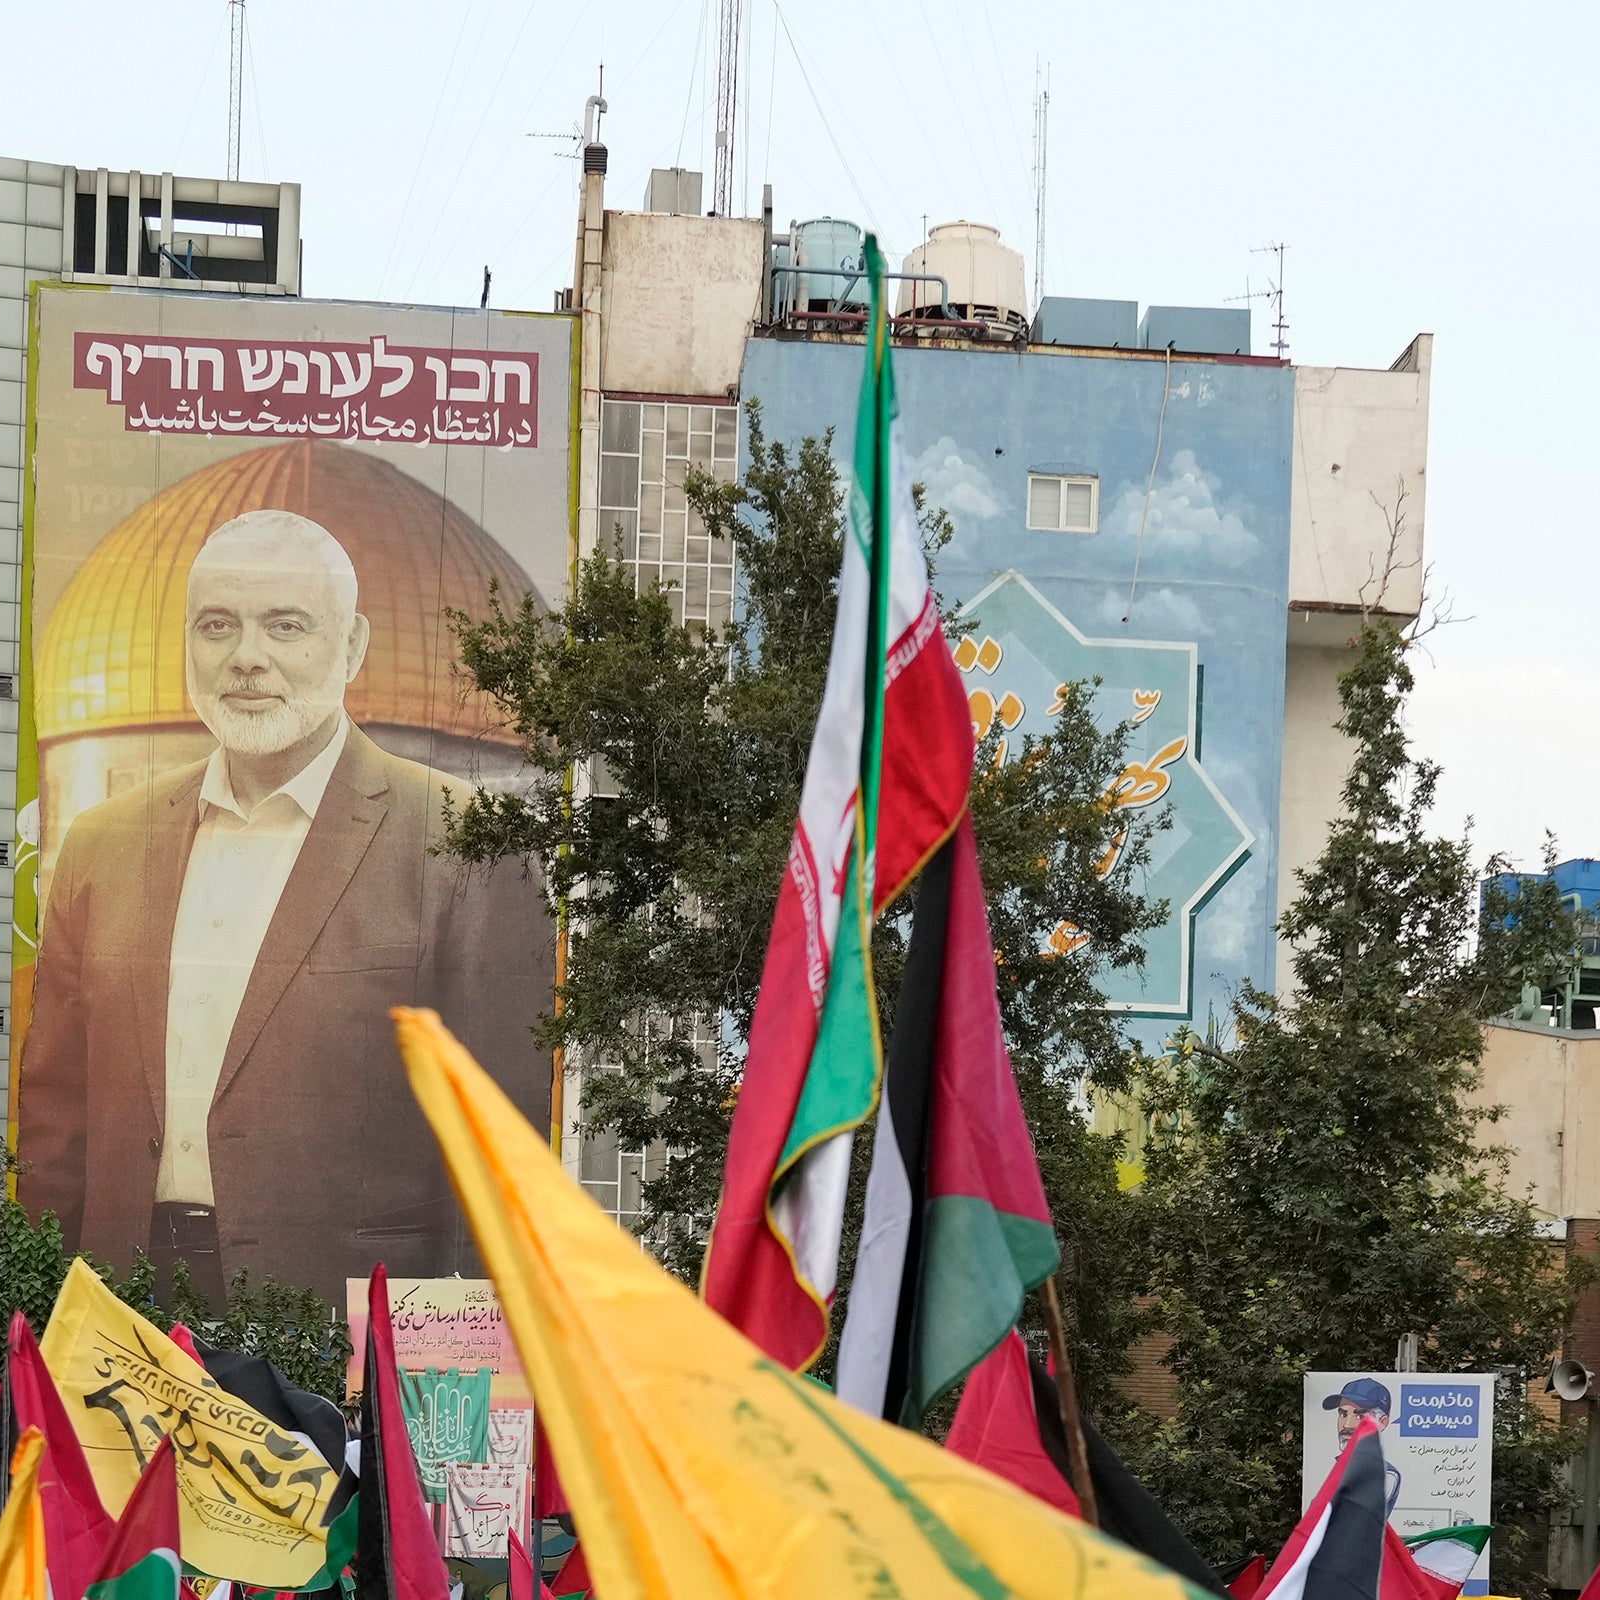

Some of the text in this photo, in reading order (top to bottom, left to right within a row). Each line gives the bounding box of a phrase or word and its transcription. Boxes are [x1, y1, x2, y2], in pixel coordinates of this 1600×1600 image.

[86, 338, 530, 404] חכו לעונש חריף
[129, 395, 532, 453] در انتظار مجازات سخت باشید
